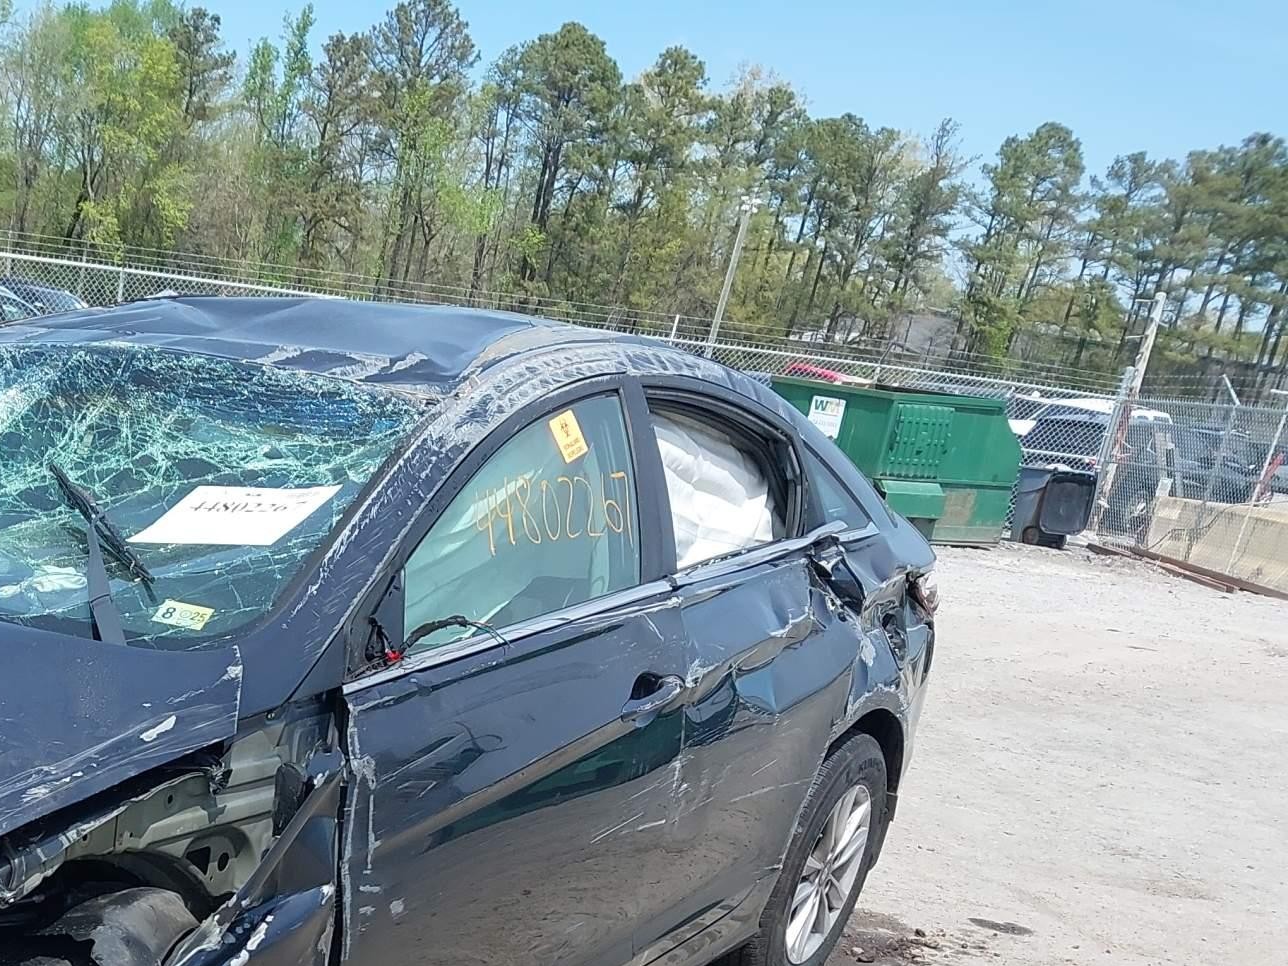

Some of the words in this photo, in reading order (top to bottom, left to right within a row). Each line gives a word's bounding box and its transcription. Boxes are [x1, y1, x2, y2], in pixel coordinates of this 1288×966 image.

[475, 471, 634, 557] 44802267
[162, 606, 176, 619] 8
[190, 611, 208, 622] 25
